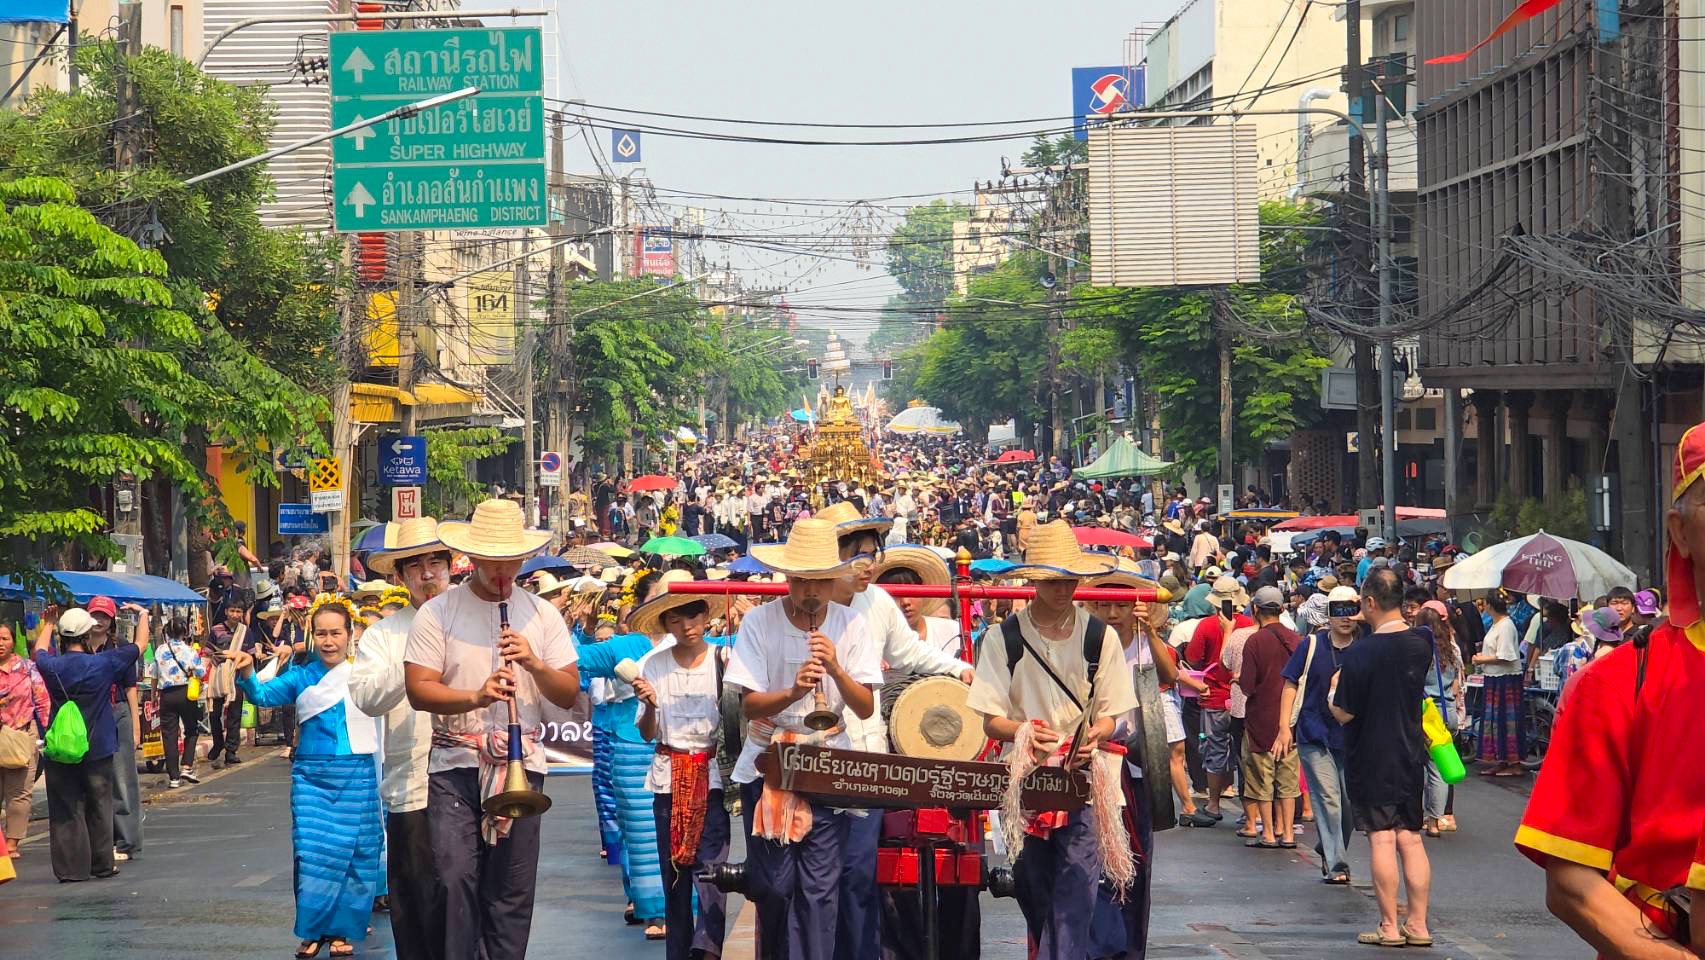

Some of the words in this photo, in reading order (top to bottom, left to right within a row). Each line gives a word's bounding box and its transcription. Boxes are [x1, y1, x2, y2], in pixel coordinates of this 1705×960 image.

[384, 31, 532, 75] สถานีรถไฟ
[399, 76, 453, 92] RAILWAY
[463, 74, 519, 90] STATION
[390, 144, 445, 160] SUPER
[453, 142, 528, 159] HIGHWAY
[382, 168, 538, 206] อำเภอสันกำแพง
[381, 207, 478, 225] SANKAMPHAENG
[490, 205, 541, 222] DISTRICT
[383, 465, 421, 474] Ketawa
[832, 778, 909, 797] อำเภอหางดง
